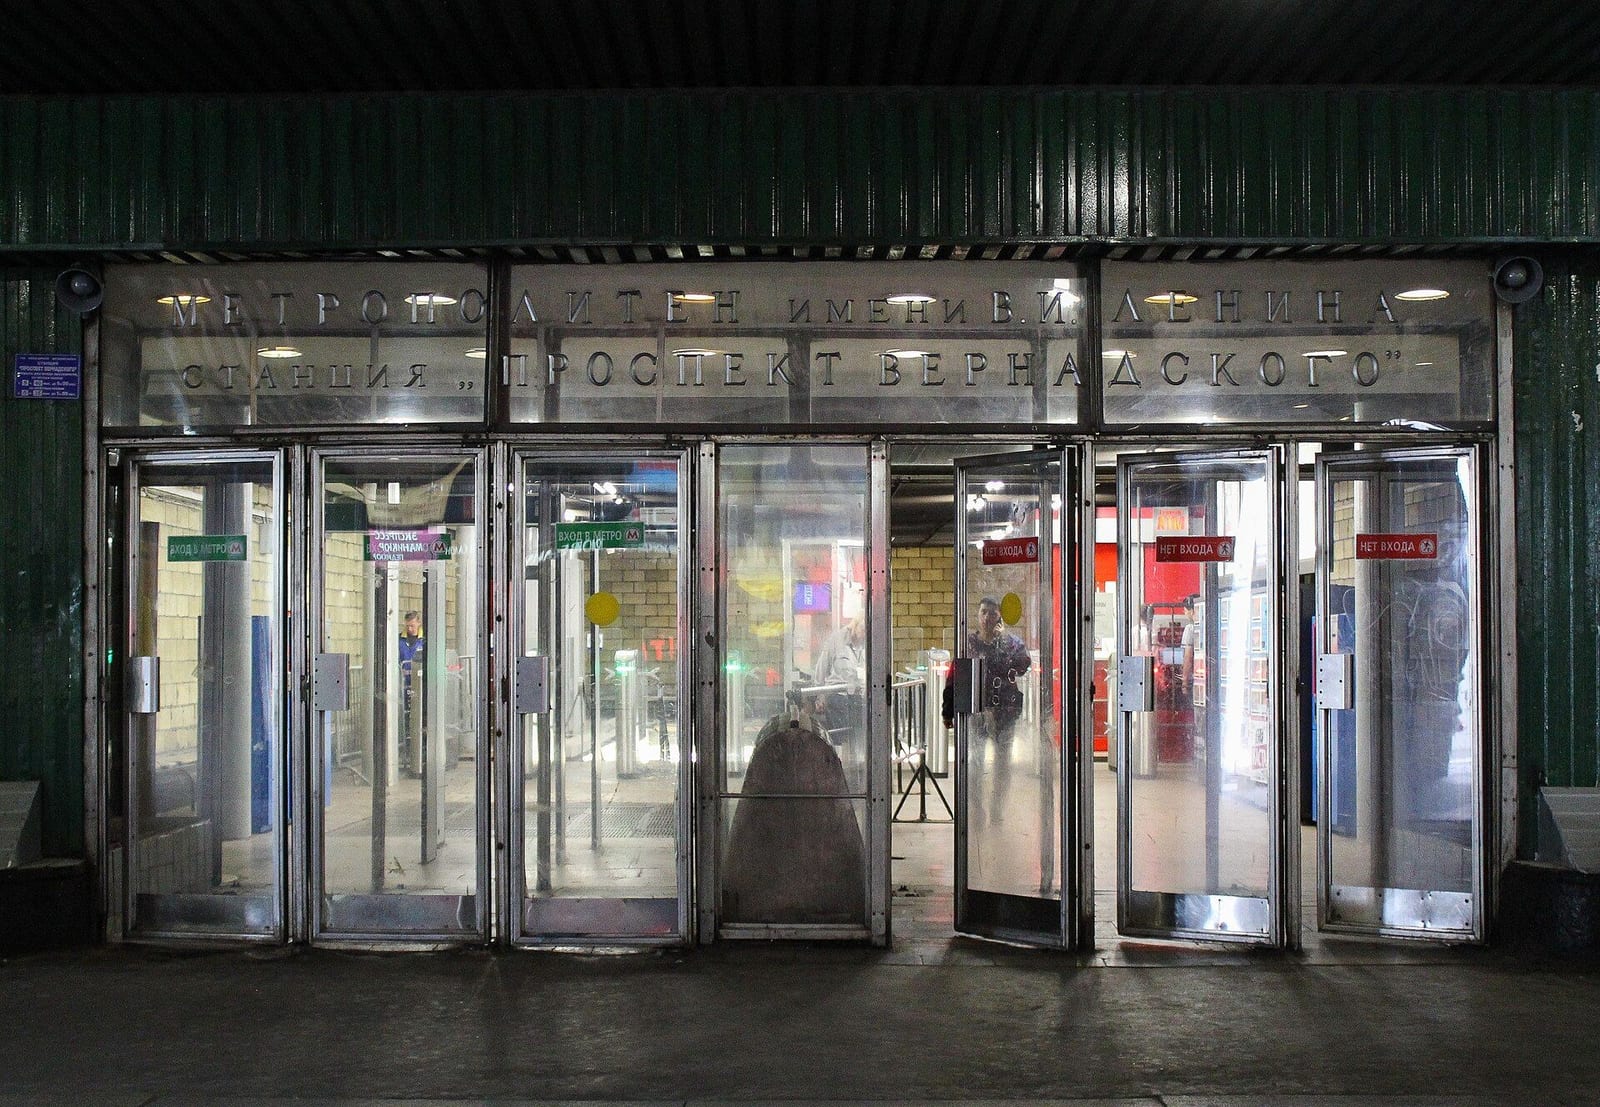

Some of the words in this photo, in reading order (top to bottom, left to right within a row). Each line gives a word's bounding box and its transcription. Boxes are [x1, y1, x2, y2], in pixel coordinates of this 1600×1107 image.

[171, 288, 741, 326] МЕТРОПОЛИТЕН
[788, 298, 967, 324] ИМЕНИ
[1111, 287, 1402, 324] ЛЕНИНА
[182, 364, 428, 390] СТАНЦИЯ
[558, 531, 583, 543] ВХОД
[584, 531, 591, 541] В
[593, 530, 623, 541] МЕТРО
[170, 544, 192, 556] ВХОД
[201, 544, 227, 554] МЕТРО
[985, 546, 998, 558] НЕТ
[999, 545, 1024, 558] ВХОДА
[1159, 544, 1178, 555] НЕТ
[1179, 544, 1214, 556] ВХОДА
[1360, 542, 1378, 552] НЕТ
[1381, 542, 1416, 553] ВХОДА
